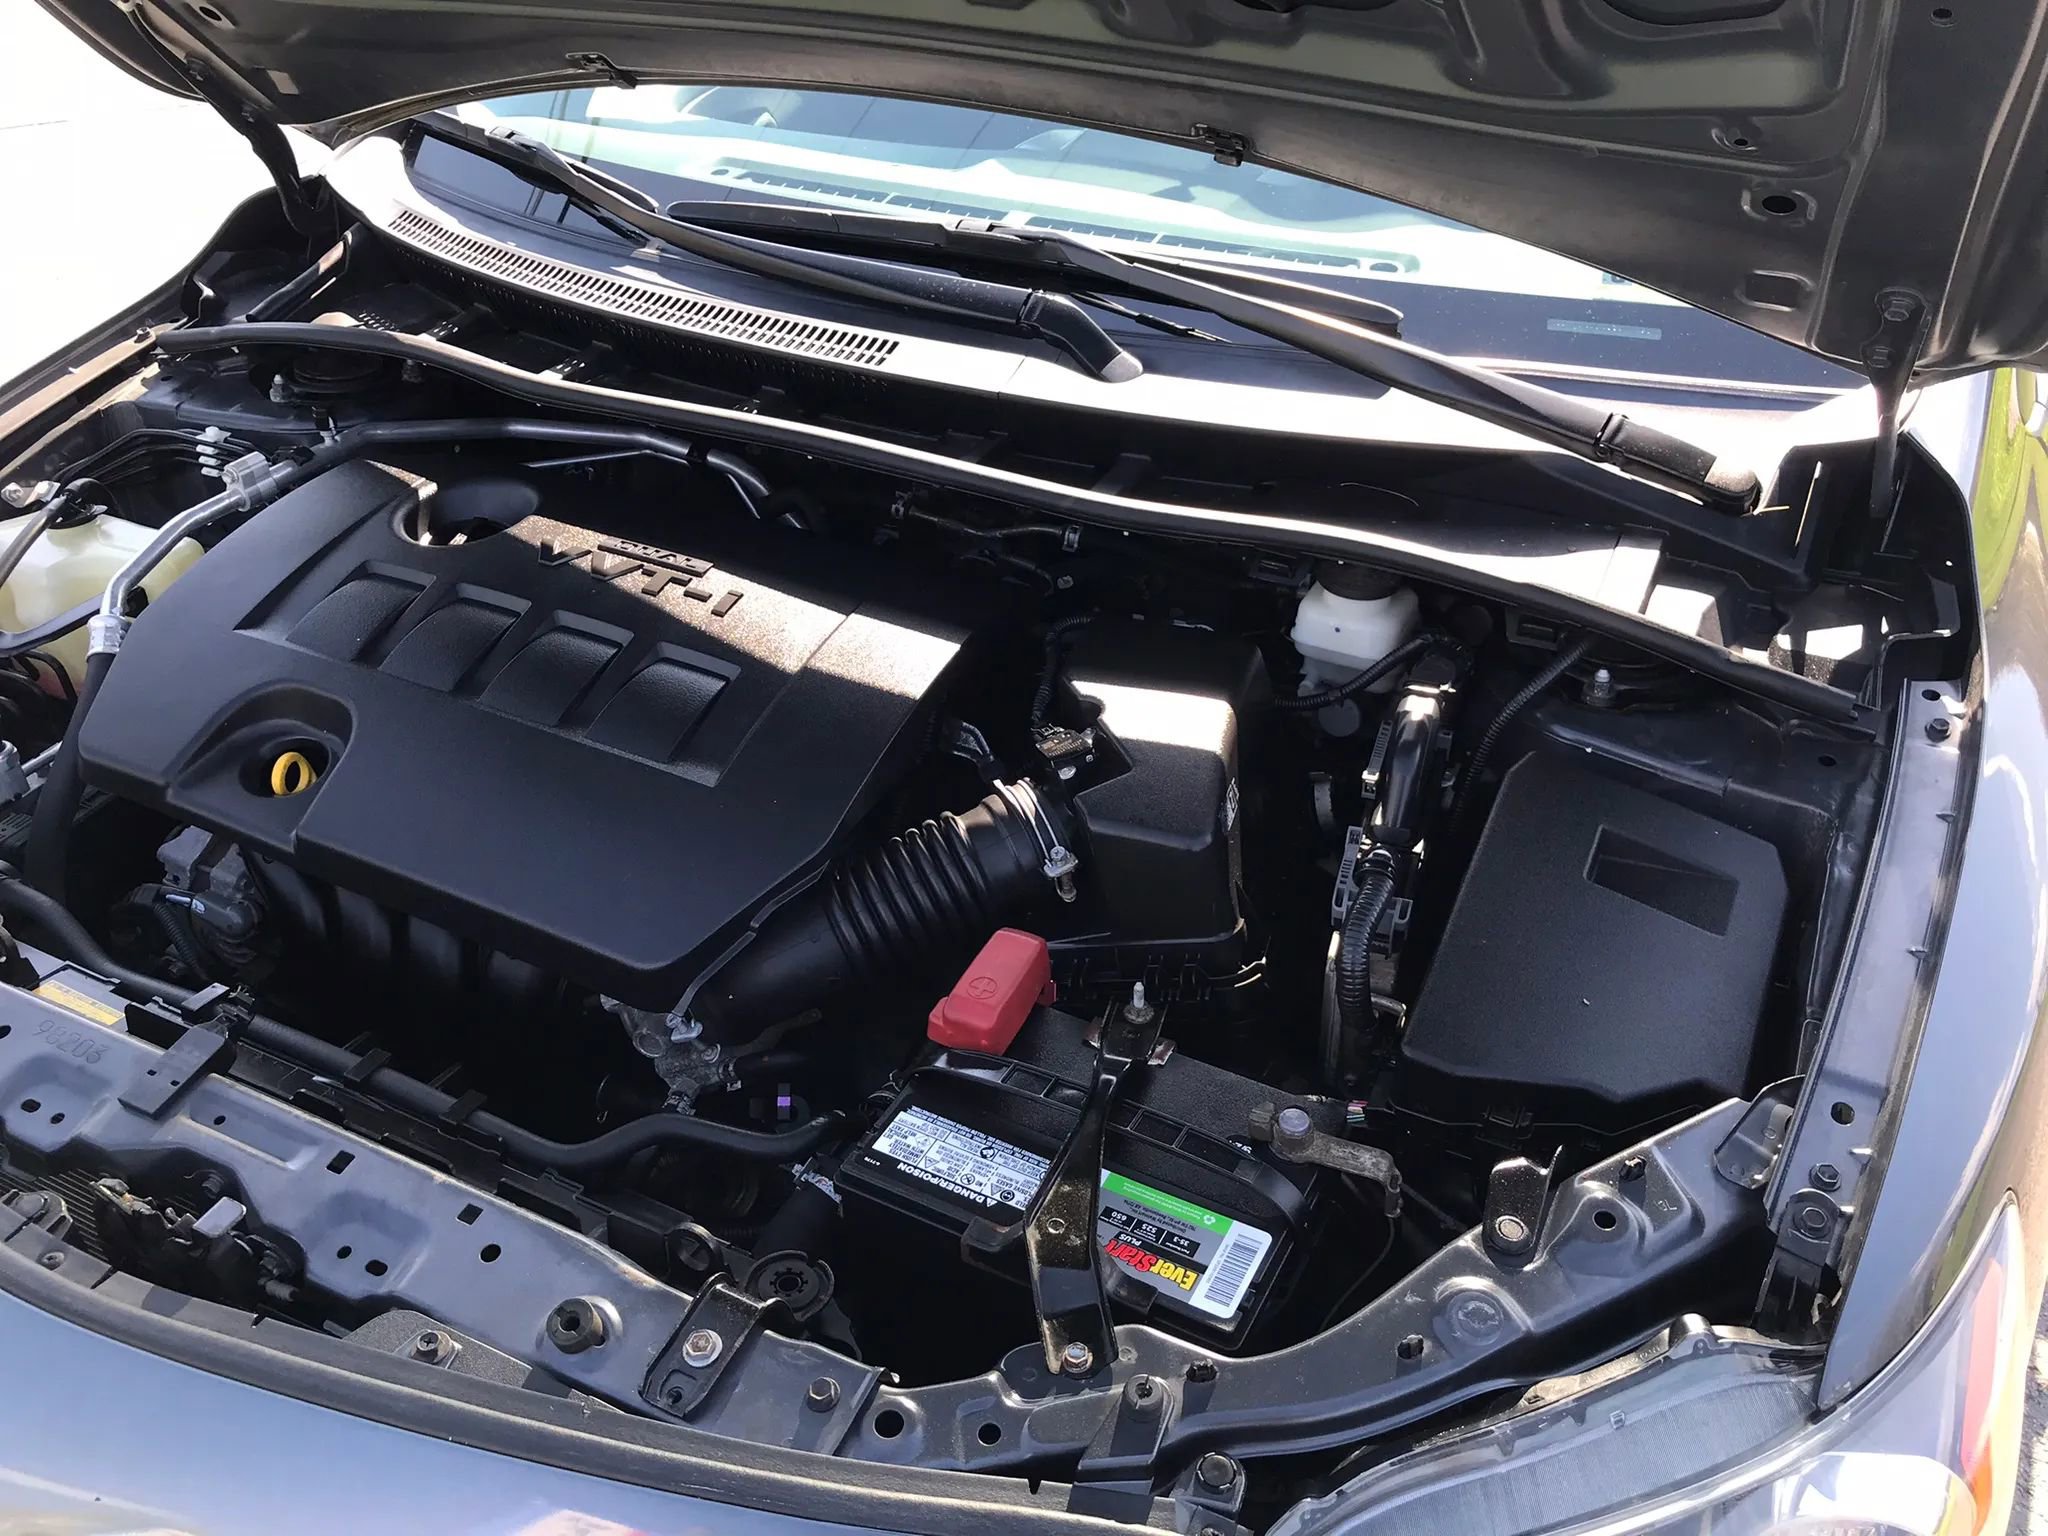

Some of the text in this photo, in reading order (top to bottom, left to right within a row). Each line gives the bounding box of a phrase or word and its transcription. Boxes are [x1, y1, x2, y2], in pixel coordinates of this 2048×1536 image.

[613, 541, 699, 569] DUAL
[895, 1161, 986, 1203] DANGER/POISON
[1111, 1211, 1128, 1221] 650
[1141, 1223, 1157, 1234] 525
[1118, 1233, 1142, 1247] PLUS
[1173, 1236, 1190, 1247] 35-3
[1103, 1239, 1199, 1291] EverStart
